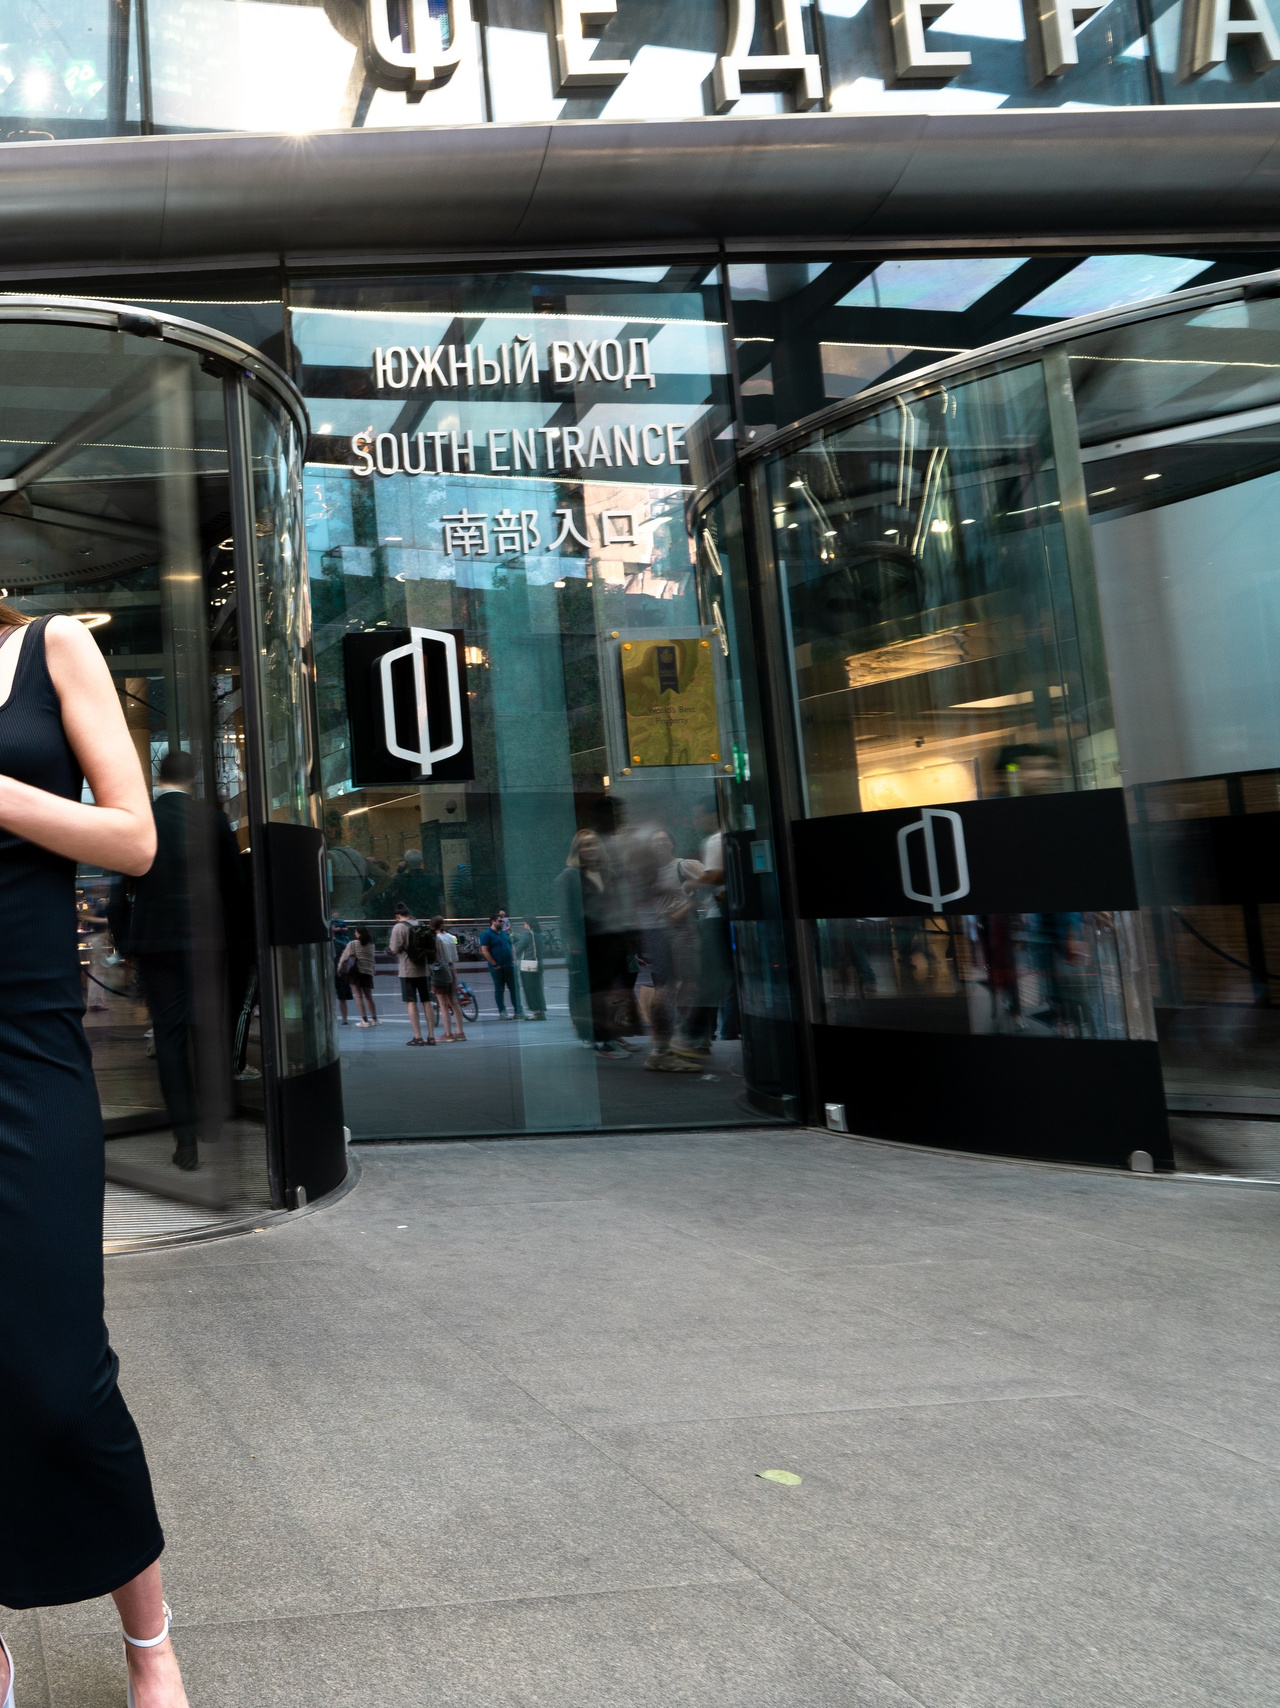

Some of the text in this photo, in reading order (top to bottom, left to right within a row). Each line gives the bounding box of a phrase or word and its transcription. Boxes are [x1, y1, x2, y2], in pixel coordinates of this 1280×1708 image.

[373, 333, 657, 390] ЮЖНЫЙ ВХОД
[351, 422, 691, 477] SOUTH ENTRANCE
[441, 507, 640, 556] 南部入口
